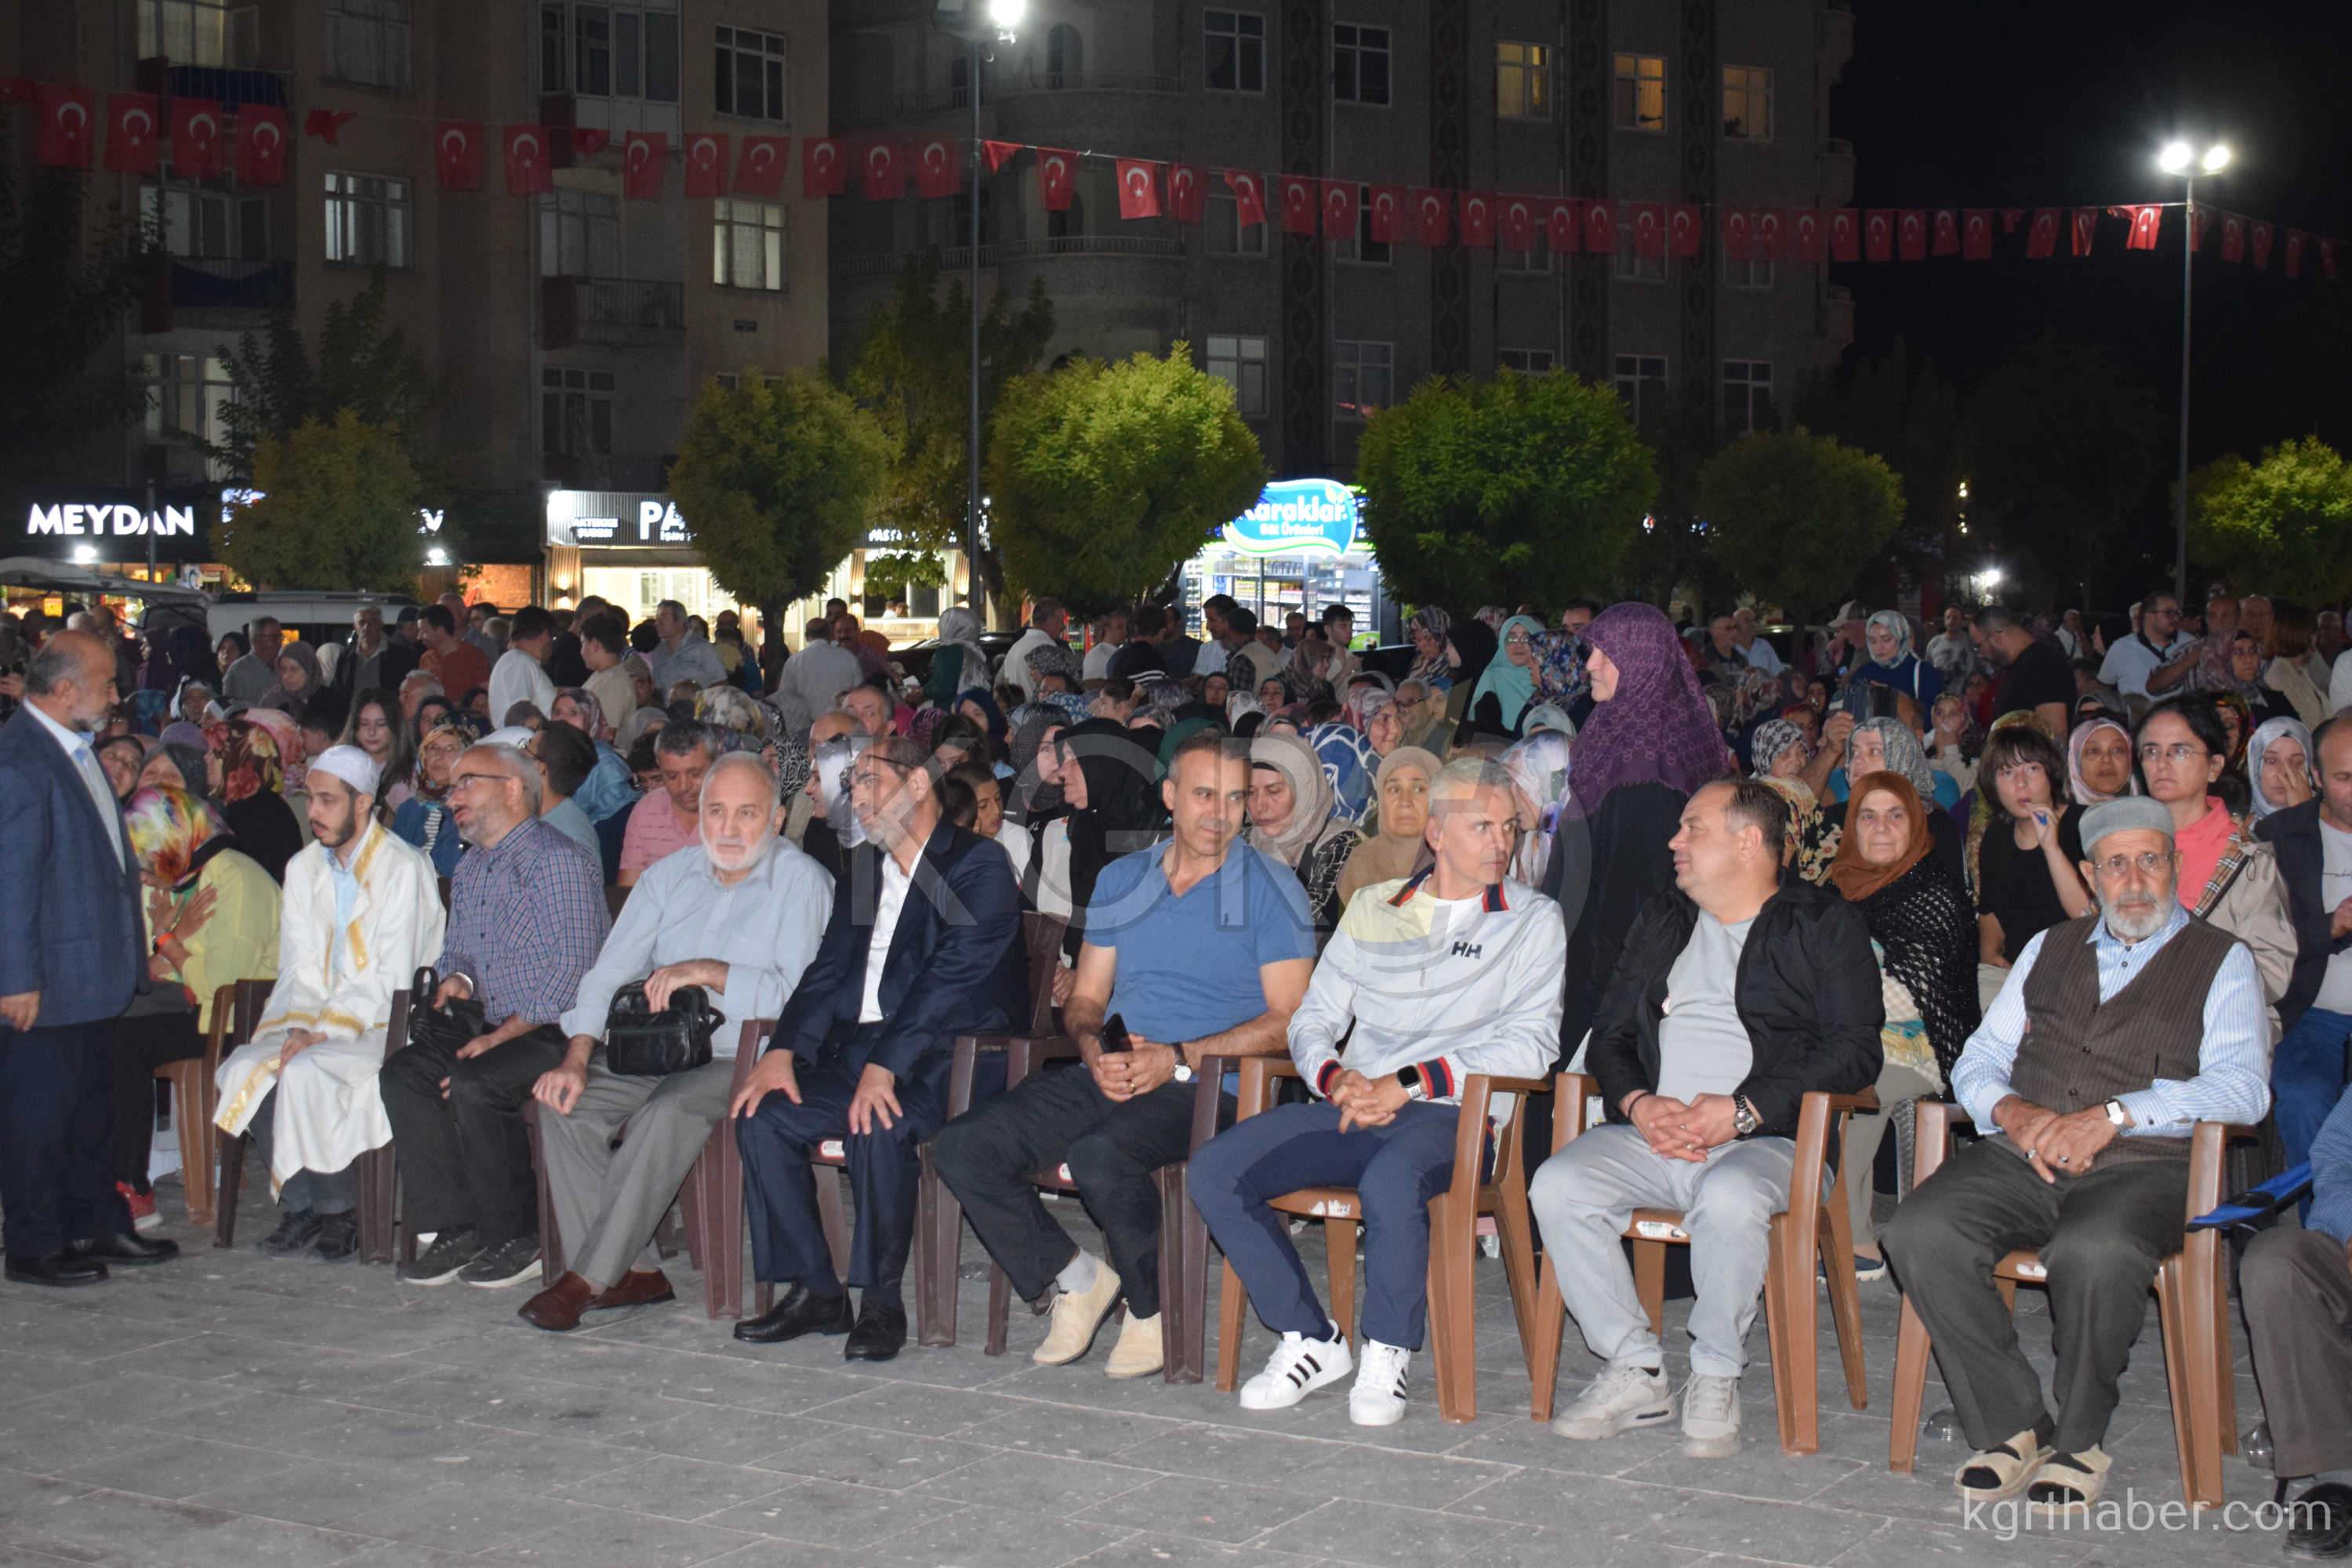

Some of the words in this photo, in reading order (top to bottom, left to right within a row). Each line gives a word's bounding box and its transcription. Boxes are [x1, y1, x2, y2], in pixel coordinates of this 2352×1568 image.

[27, 503, 194, 536] MEYDAN
[640, 501, 686, 540] PA
[1451, 941, 1482, 960] HH
